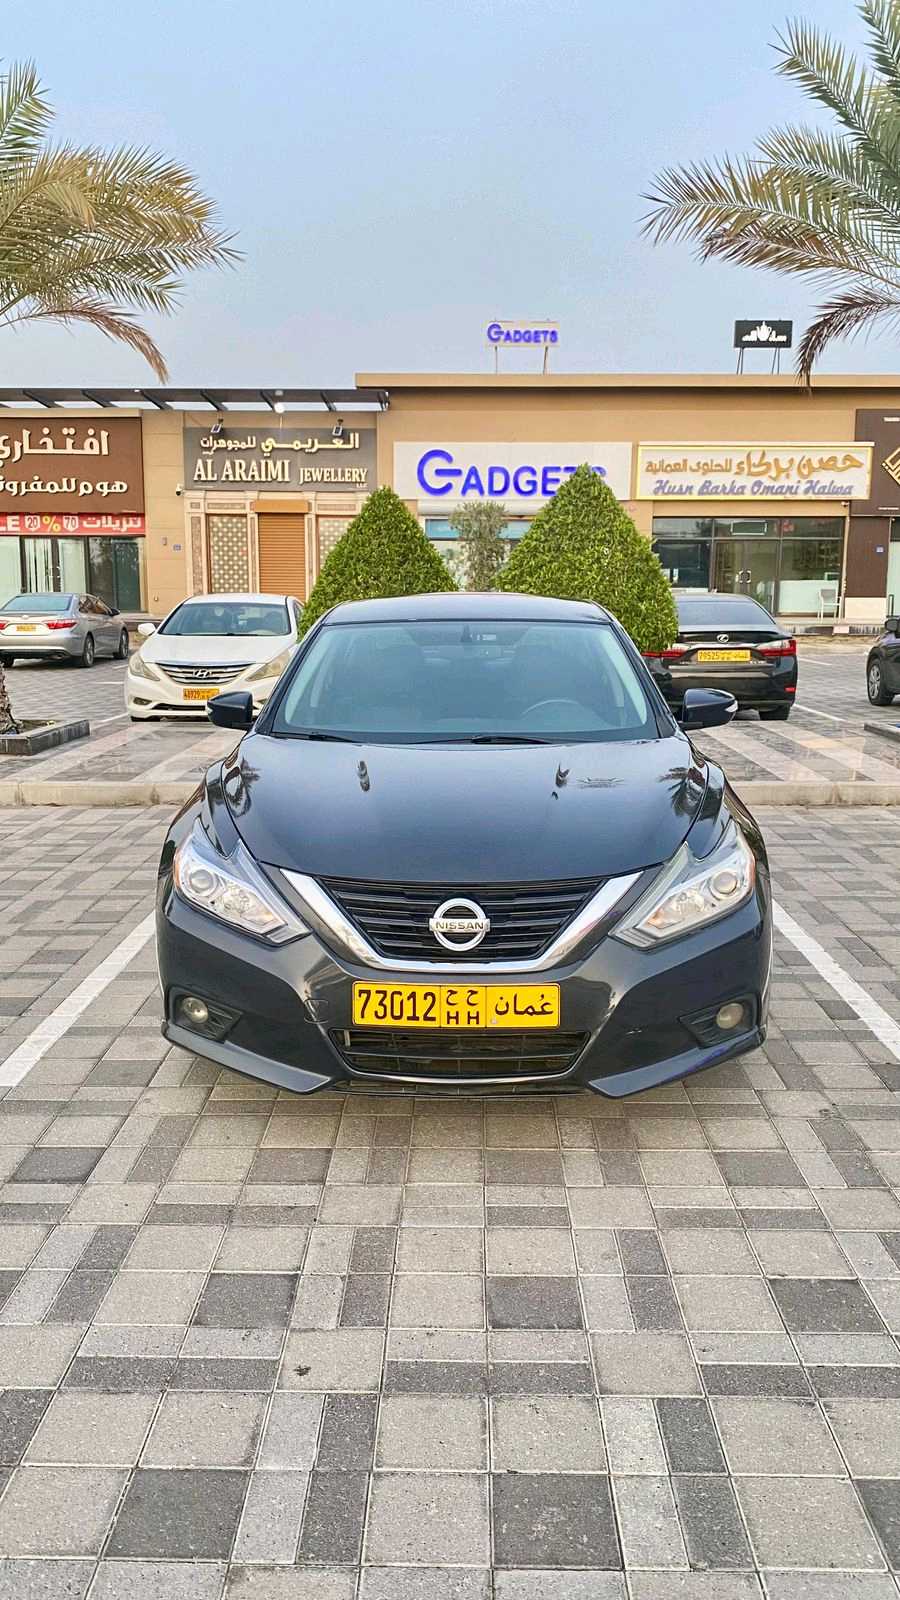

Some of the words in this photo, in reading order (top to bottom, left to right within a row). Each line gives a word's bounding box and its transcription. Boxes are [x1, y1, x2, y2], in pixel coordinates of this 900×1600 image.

[487, 323, 558, 343] GADGETS
[200, 435, 257, 455] للمجوهرات
[261, 433, 360, 456] العريمي
[193, 459, 217, 481] AL
[221, 459, 291, 482] ARAIMI
[300, 468, 368, 484] JEWELLERY
[645, 458, 688, 475] العمانية
[733, 450, 794, 481] بركاء
[797, 454, 864, 479] حصن
[653, 479, 694, 496] Husn
[698, 480, 747, 496] Barka
[750, 479, 799, 496] Omani
[803, 479, 854, 496] Halwa
[26, 517, 38, 528] 20
[64, 517, 78, 528] 70
[83, 516, 141, 532] تنزيلات
[435, 921, 484, 930] NISSAN
[358, 989, 437, 1022] 73012
